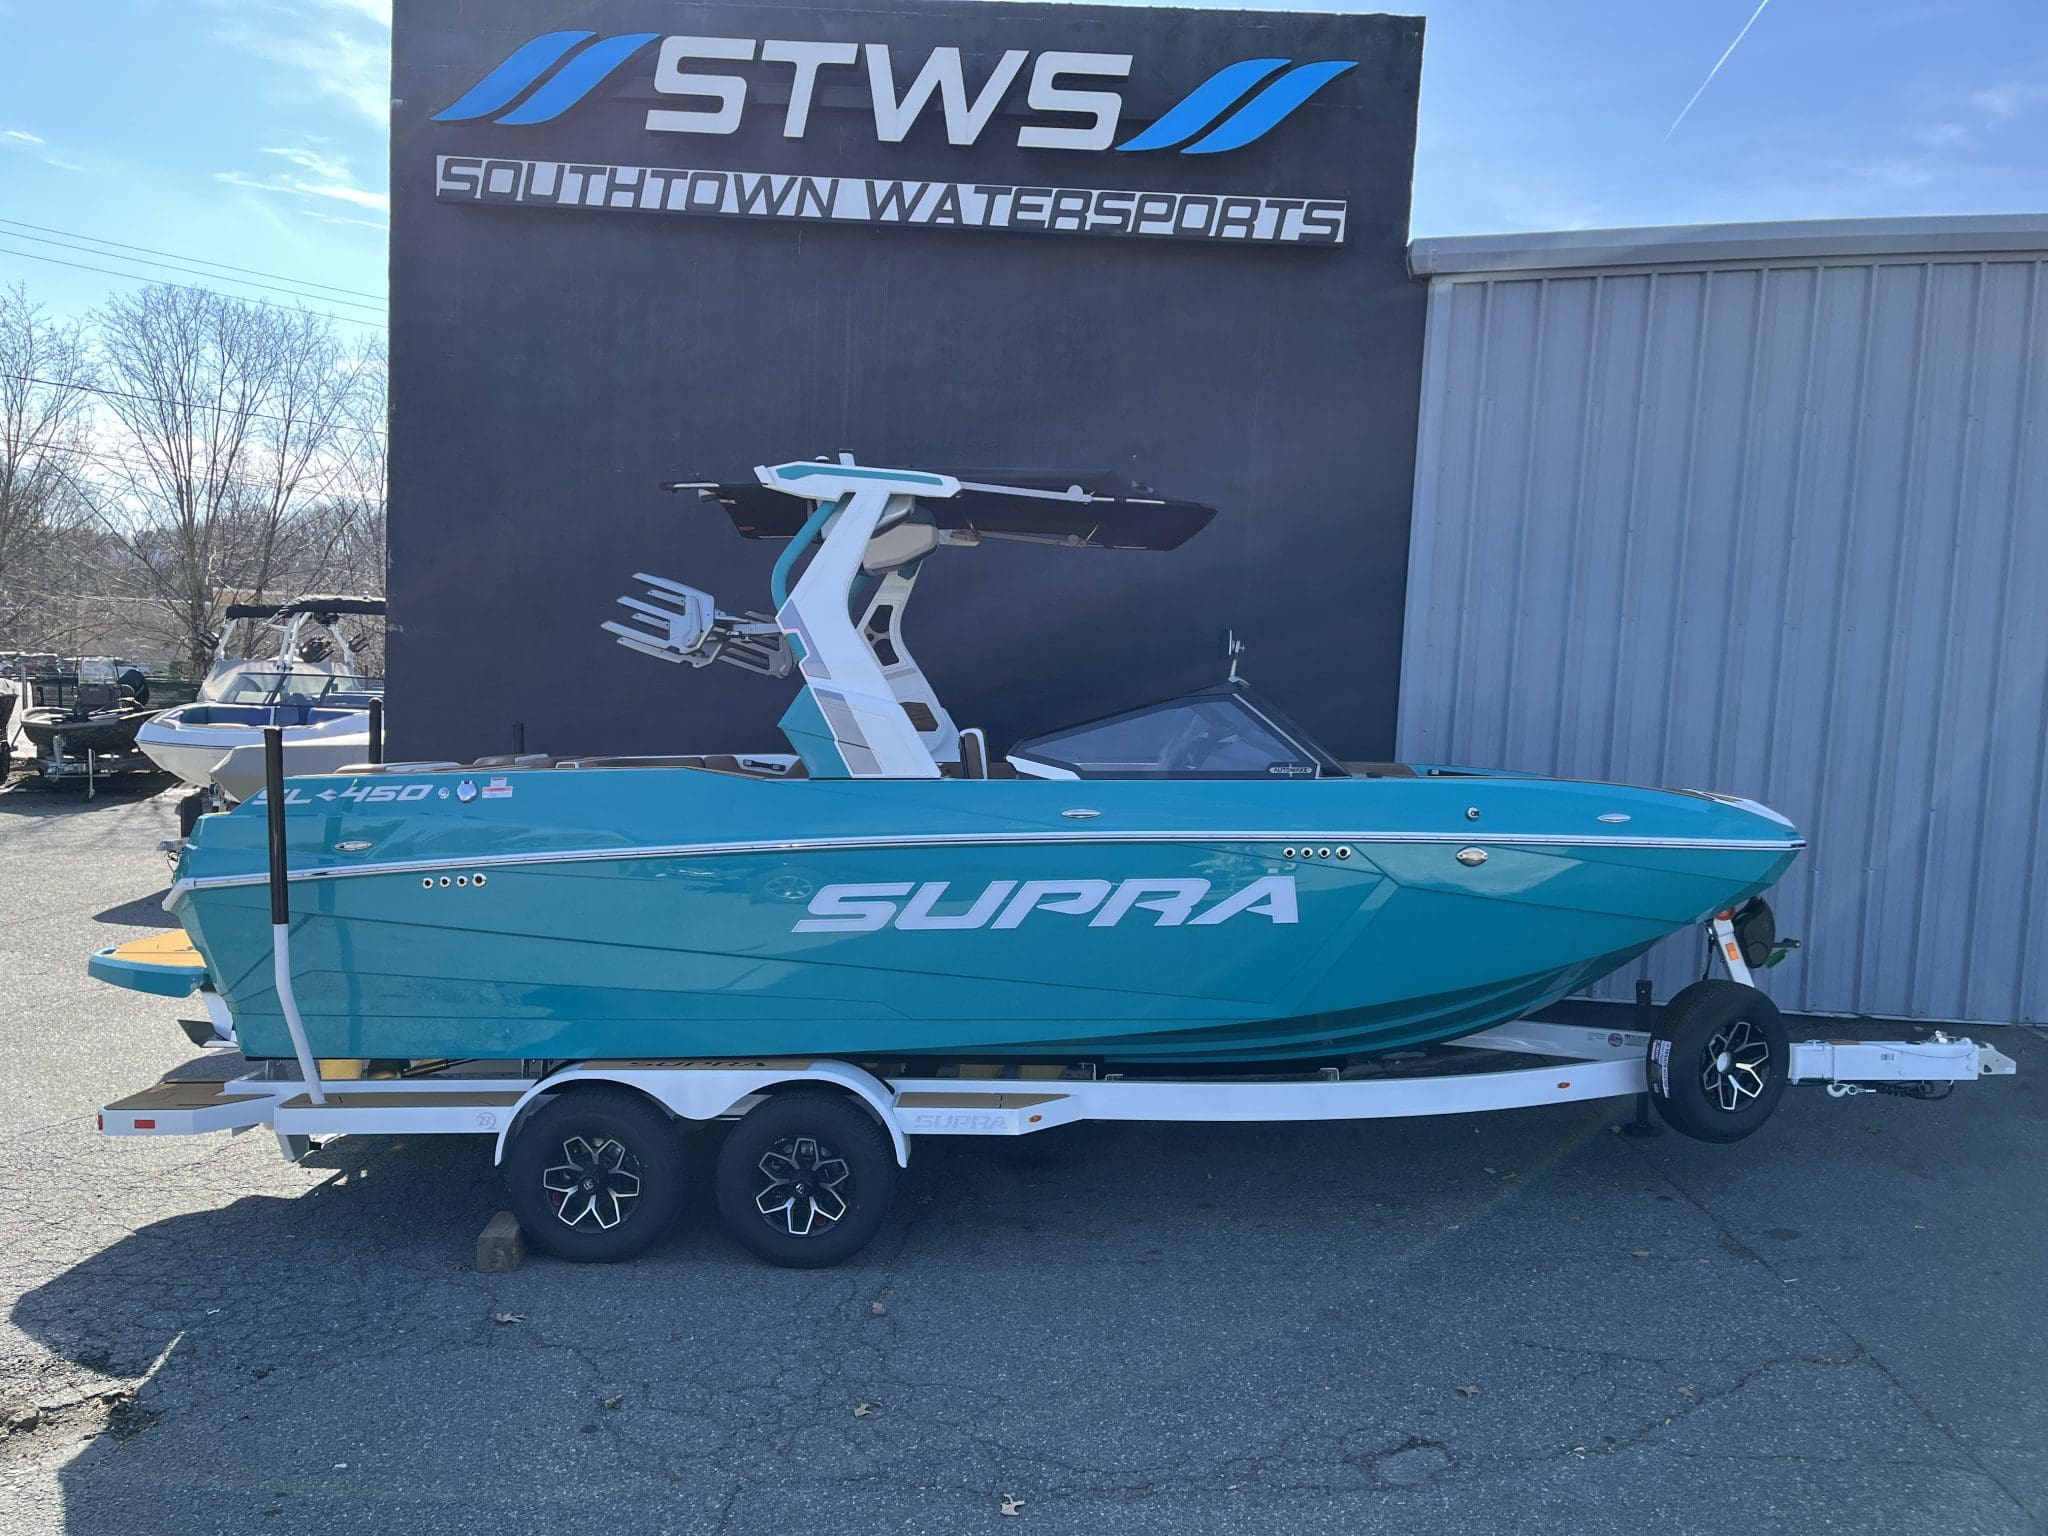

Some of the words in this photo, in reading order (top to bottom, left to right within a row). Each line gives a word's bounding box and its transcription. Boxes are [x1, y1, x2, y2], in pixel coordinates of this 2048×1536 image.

[645, 35, 1133, 150] STWS
[438, 157, 839, 219] SOUTHTOWN
[864, 179, 1346, 242] WATERSPORTS
[339, 785, 434, 802] 450
[790, 876, 1300, 932] SUPRA
[914, 1114, 1008, 1130] SUPRA
